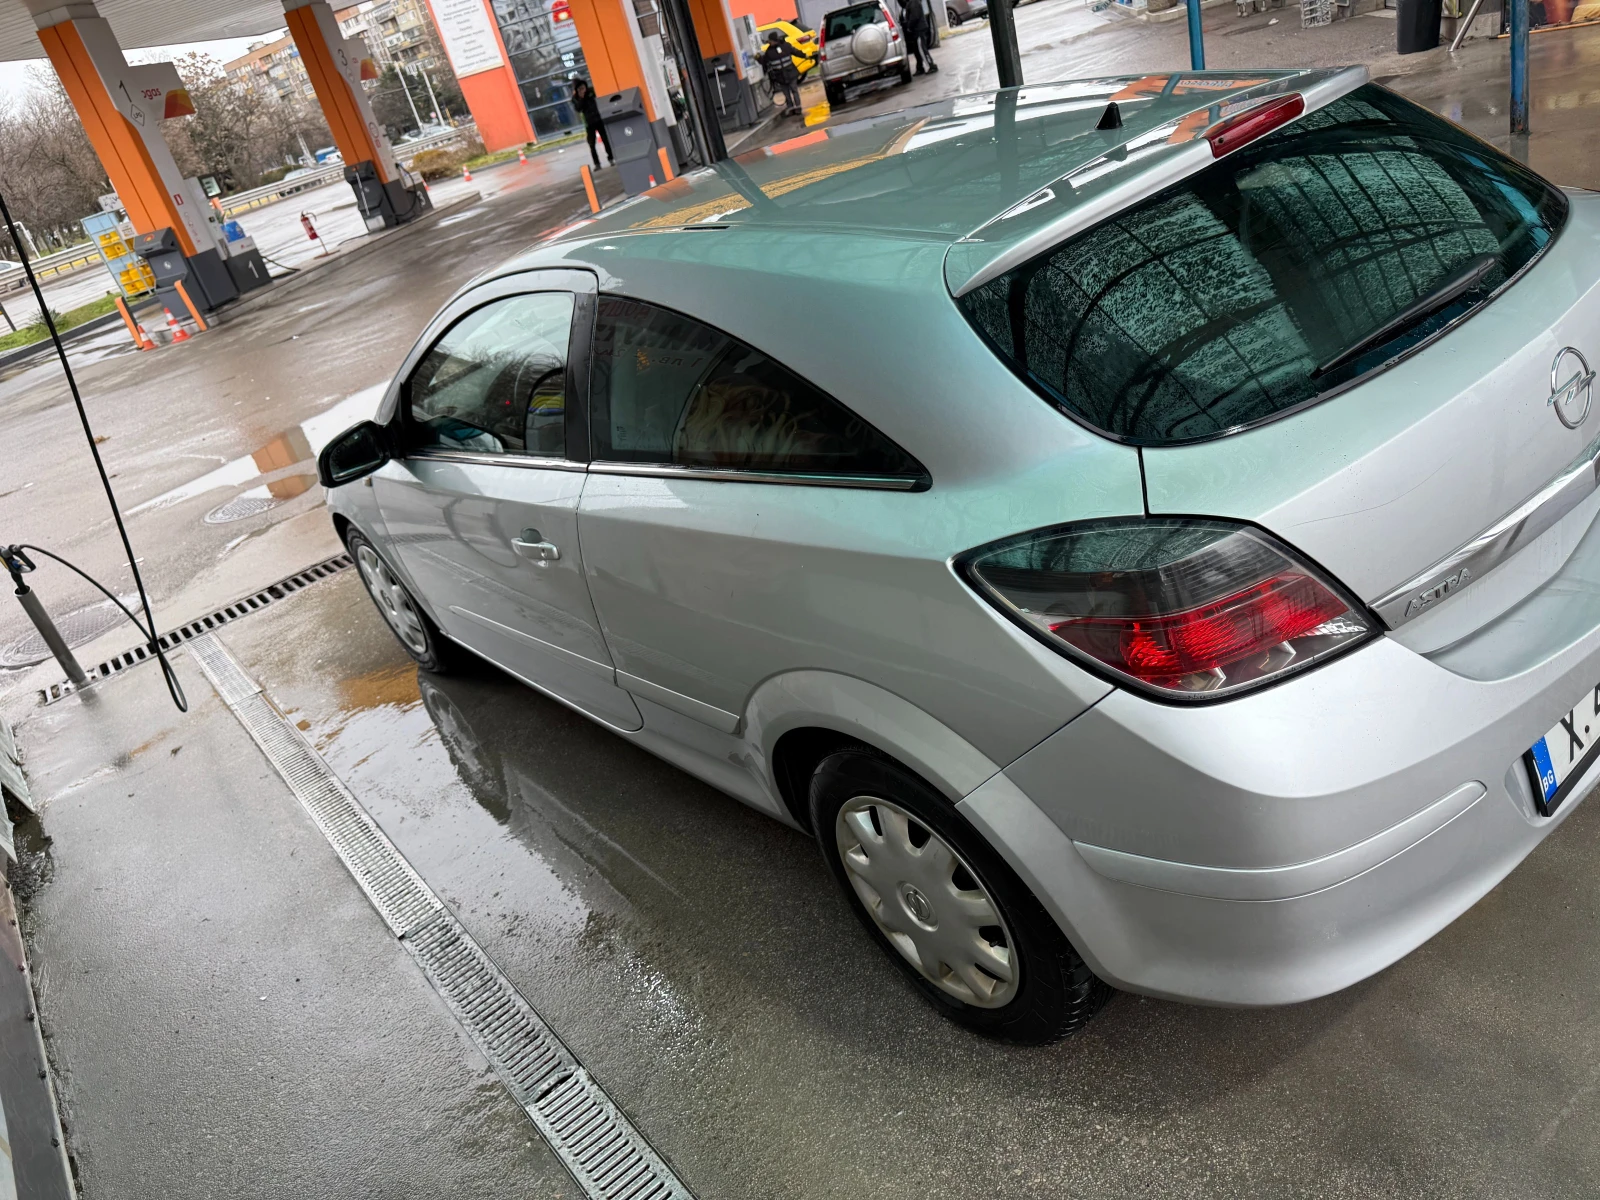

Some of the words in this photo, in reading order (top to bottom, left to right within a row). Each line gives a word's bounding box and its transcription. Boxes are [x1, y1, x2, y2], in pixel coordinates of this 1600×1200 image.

[338, 48, 348, 66] 3
[119, 80, 132, 103] 1
[248, 260, 259, 278] 1
[1404, 567, 1472, 617] ASTRA
[1542, 769, 1554, 793] BG
